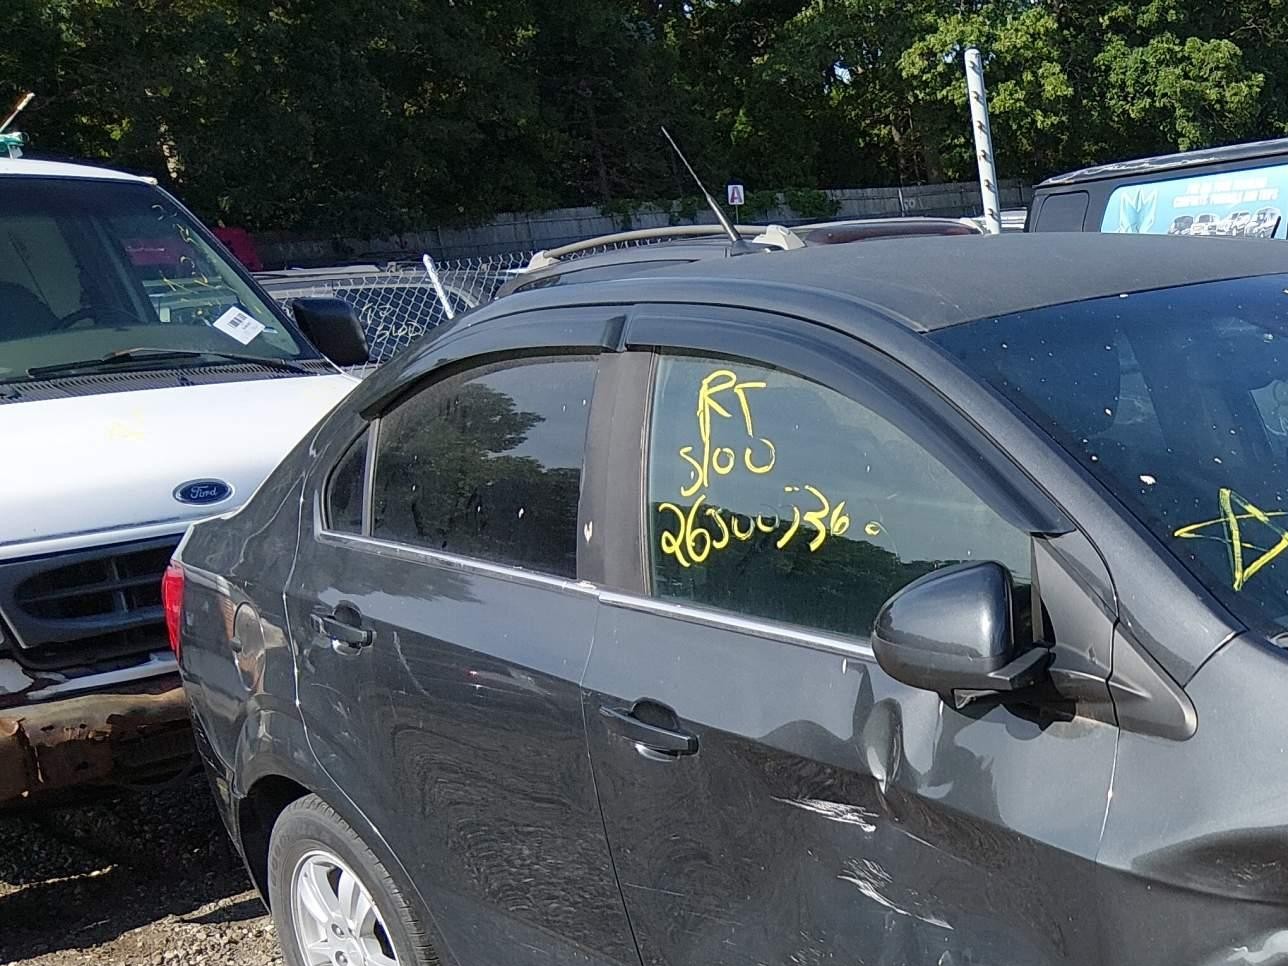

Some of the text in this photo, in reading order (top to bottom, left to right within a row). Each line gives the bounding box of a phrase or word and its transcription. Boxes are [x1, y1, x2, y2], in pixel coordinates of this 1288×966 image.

[730, 186, 743, 203] A
[696, 369, 768, 443] RT
[190, 485, 217, 499] Ford
